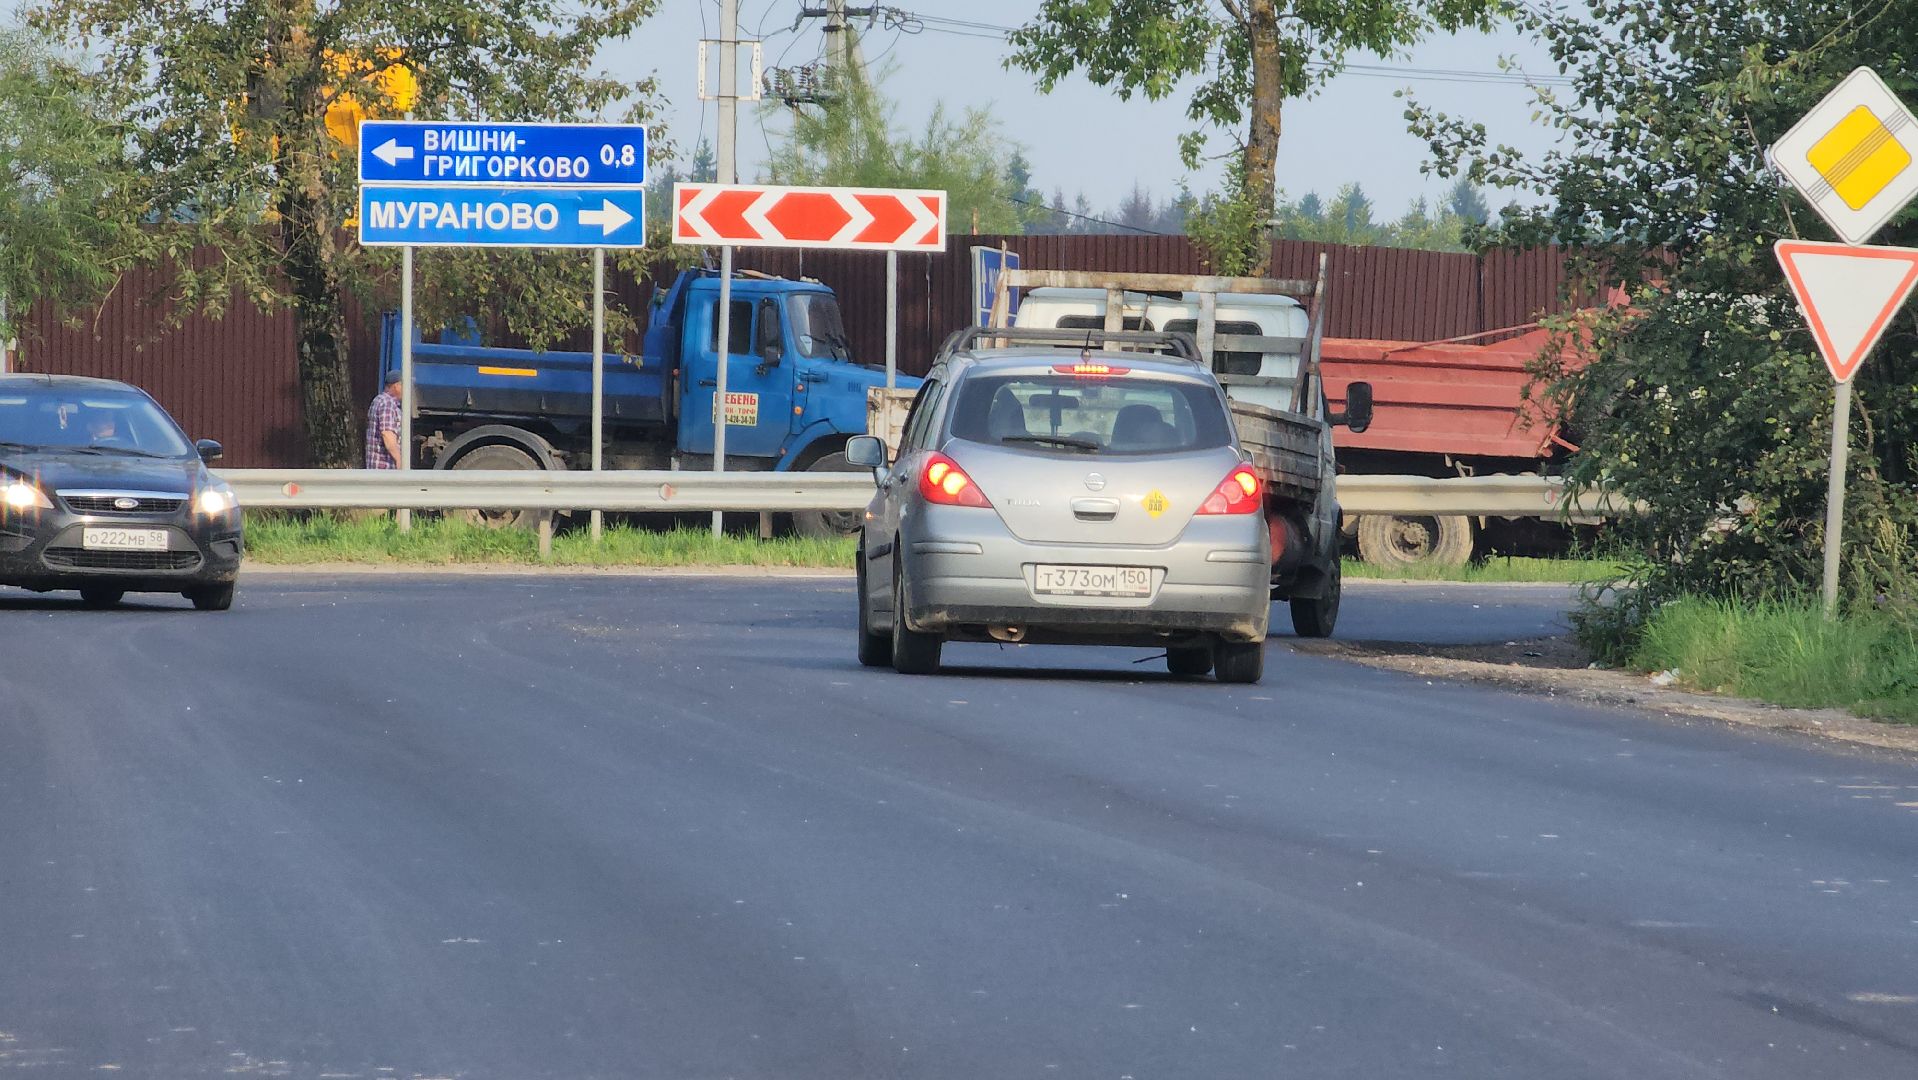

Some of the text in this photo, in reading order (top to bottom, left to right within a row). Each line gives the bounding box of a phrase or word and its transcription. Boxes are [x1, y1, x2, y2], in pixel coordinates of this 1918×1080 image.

[423, 129, 526, 153] ВИШНИ-
[423, 155, 590, 178] ГРИГОРКОВО
[600, 144, 635, 168] 0,8
[369, 201, 559, 231] МУРАНОВО
[1043, 568, 1146, 589] Т373ОМ 150
